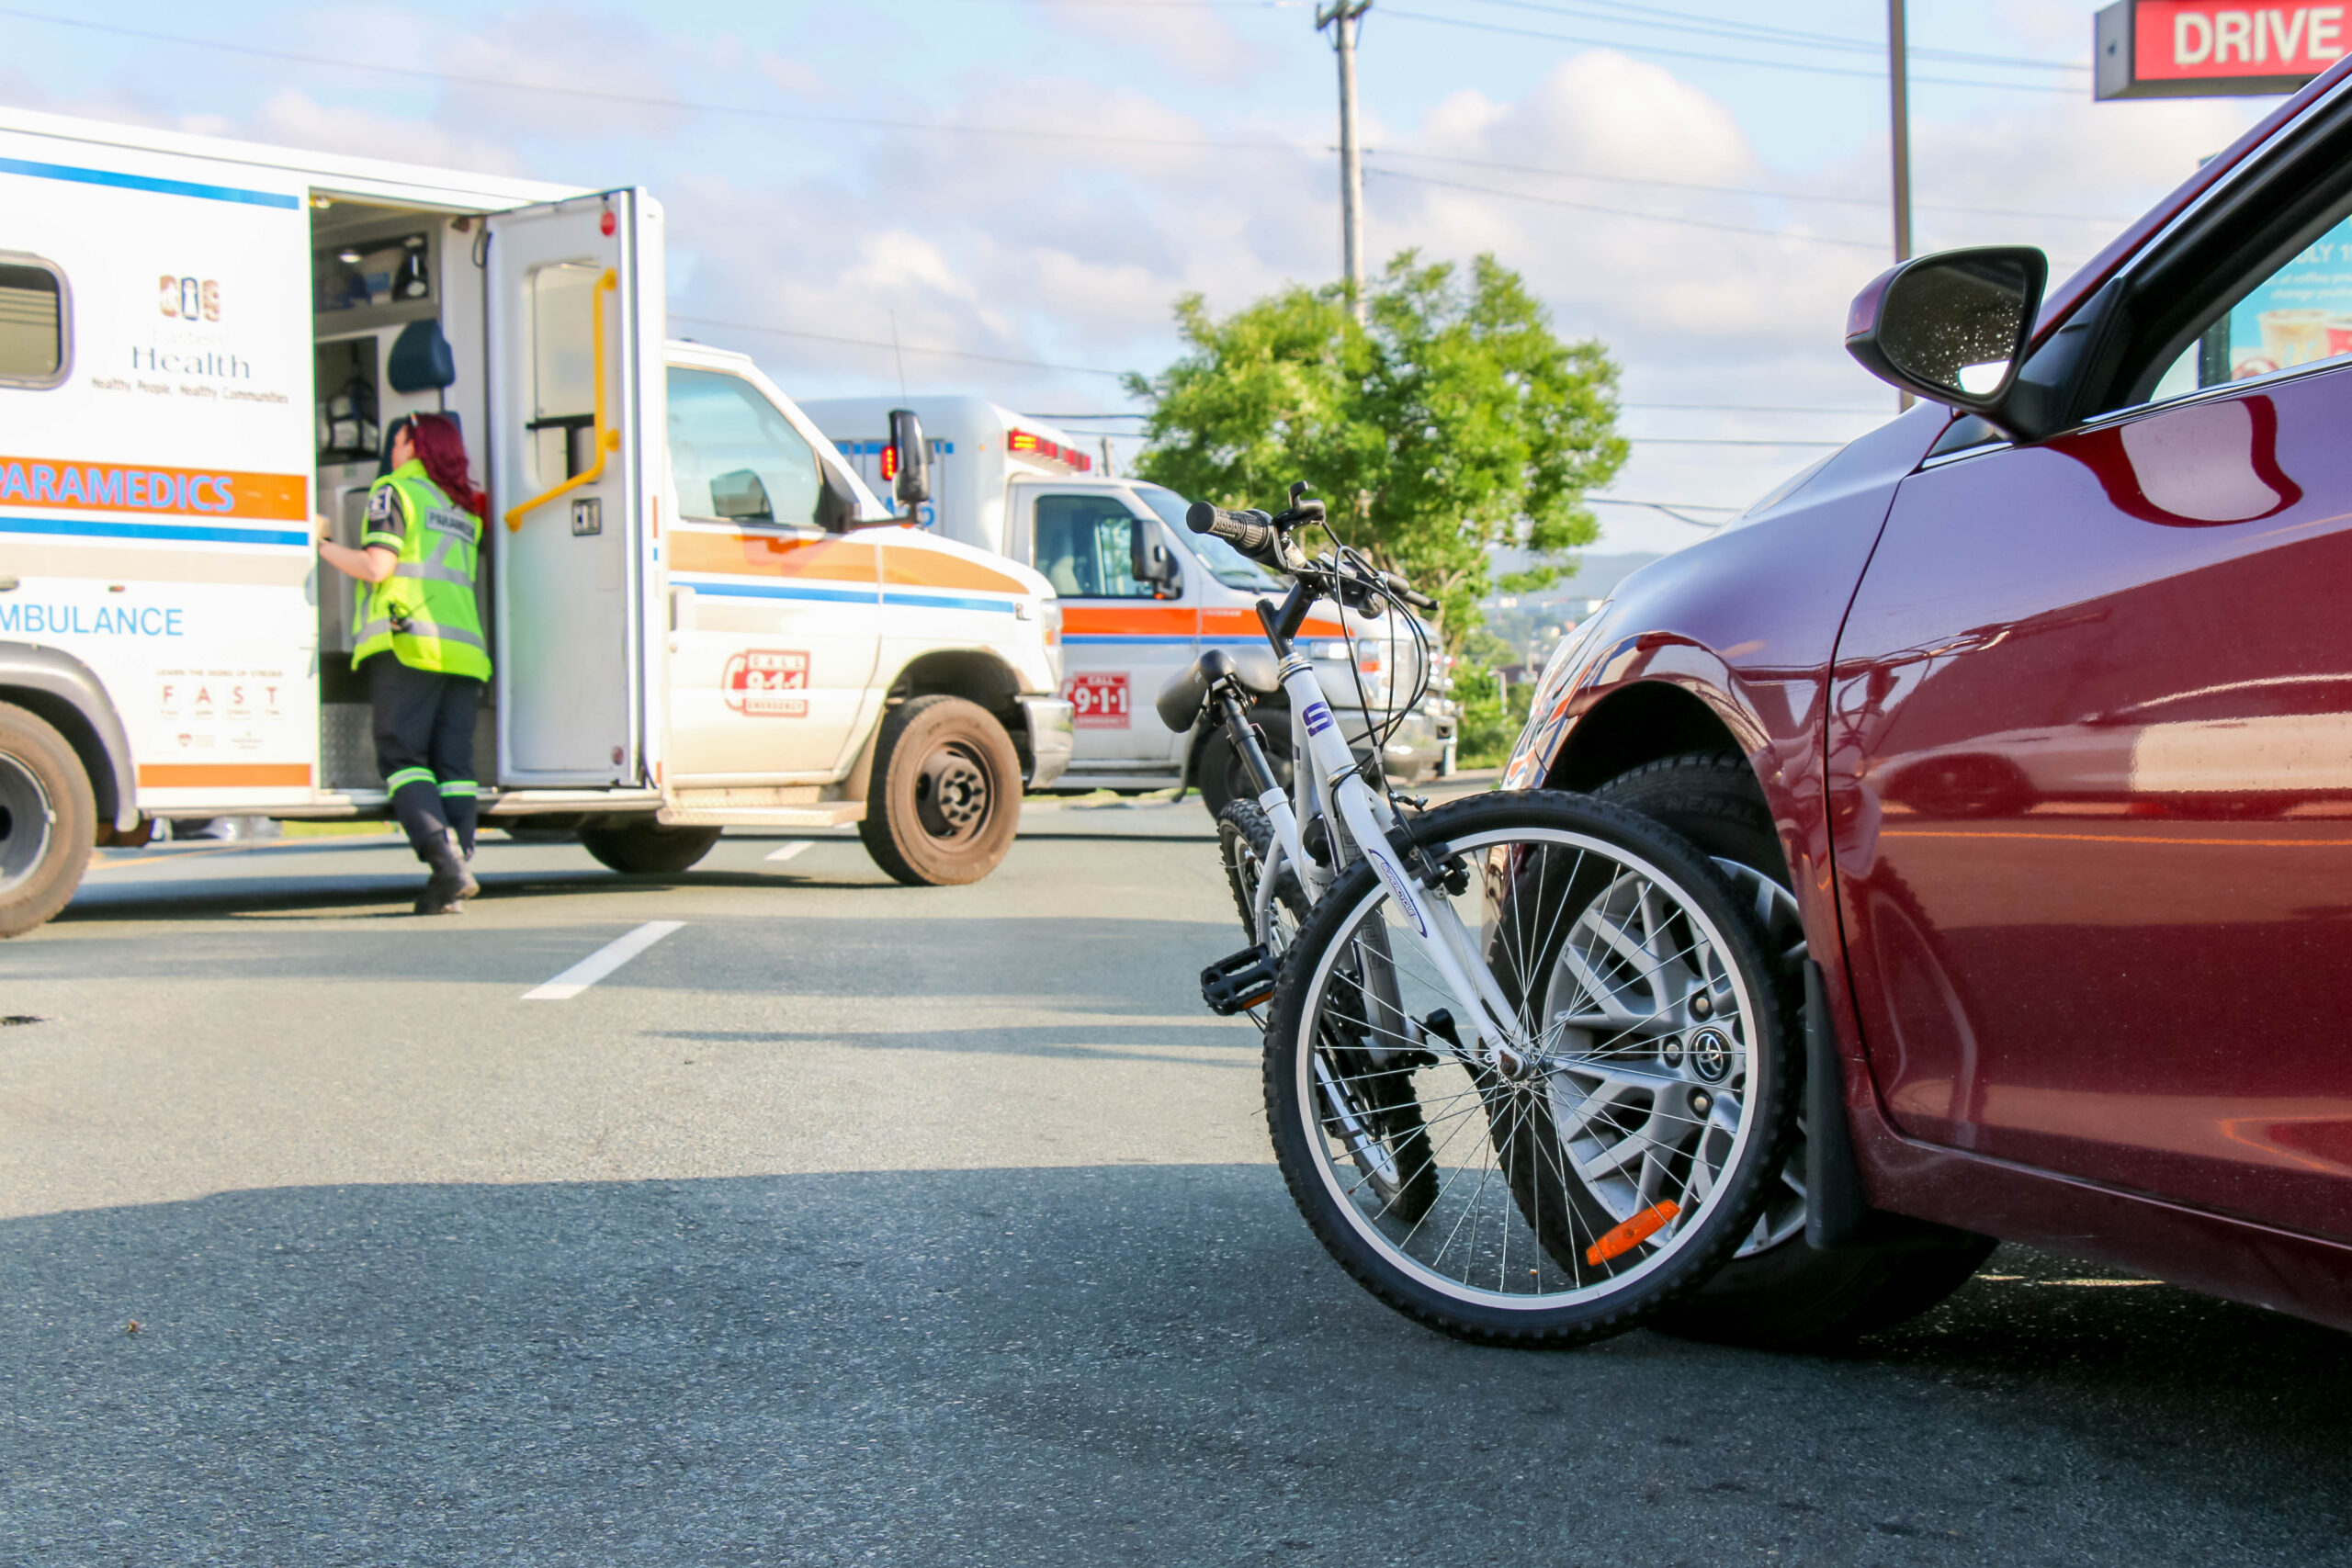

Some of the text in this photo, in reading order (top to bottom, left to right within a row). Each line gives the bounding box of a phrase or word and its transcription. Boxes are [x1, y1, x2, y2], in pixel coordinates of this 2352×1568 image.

[2174, 7, 2344, 64] DRIVE
[132, 345, 250, 378] Health
[91, 377, 130, 393] Healthy
[180, 384, 218, 400] Healthy
[223, 387, 288, 404] Communities
[0, 462, 235, 512] ARAMEDICS
[0, 604, 184, 636] MBULANCE
[1381, 862, 1416, 917] SUPERCYCLE
